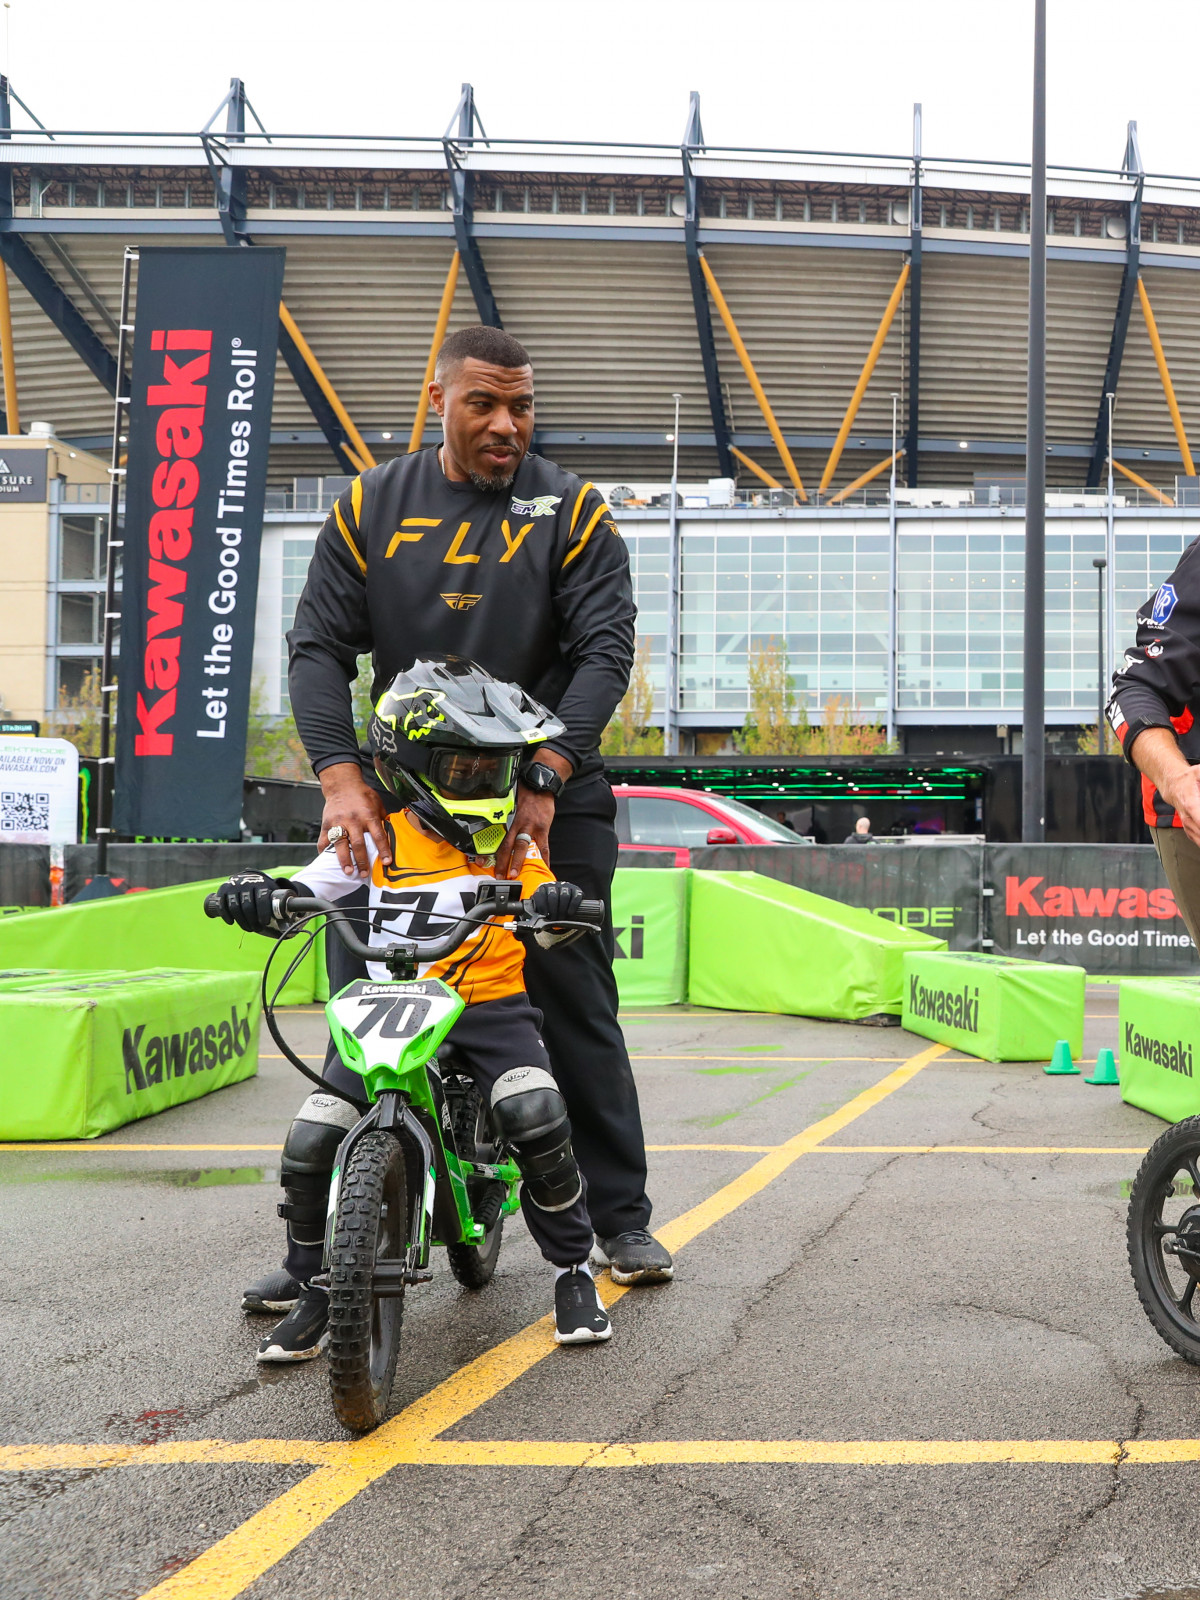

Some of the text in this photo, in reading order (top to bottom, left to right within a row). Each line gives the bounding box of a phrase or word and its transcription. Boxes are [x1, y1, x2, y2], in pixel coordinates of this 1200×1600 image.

[2, 475, 33, 485] SURE
[217, 420, 252, 519] Times
[135, 329, 213, 756] Kawasaki
[385, 518, 535, 565] FLY
[208, 527, 242, 614] Good
[203, 623, 233, 676] the
[197, 687, 229, 738] Let
[0, 755, 66, 766] AILABLE NOW ON
[0, 763, 58, 773] AWASAKI.COM
[1005, 876, 1183, 920] Kawas
[1017, 929, 1046, 944] Let
[1052, 929, 1083, 945] the
[1088, 930, 1138, 946] Good
[361, 985, 427, 995] Kawasaki
[909, 974, 980, 1033] Kawasaki
[352, 997, 432, 1039] 70
[1125, 1021, 1193, 1078] Kawasaki
[505, 1069, 531, 1083] TITAN
[311, 1097, 337, 1108] TITAN
